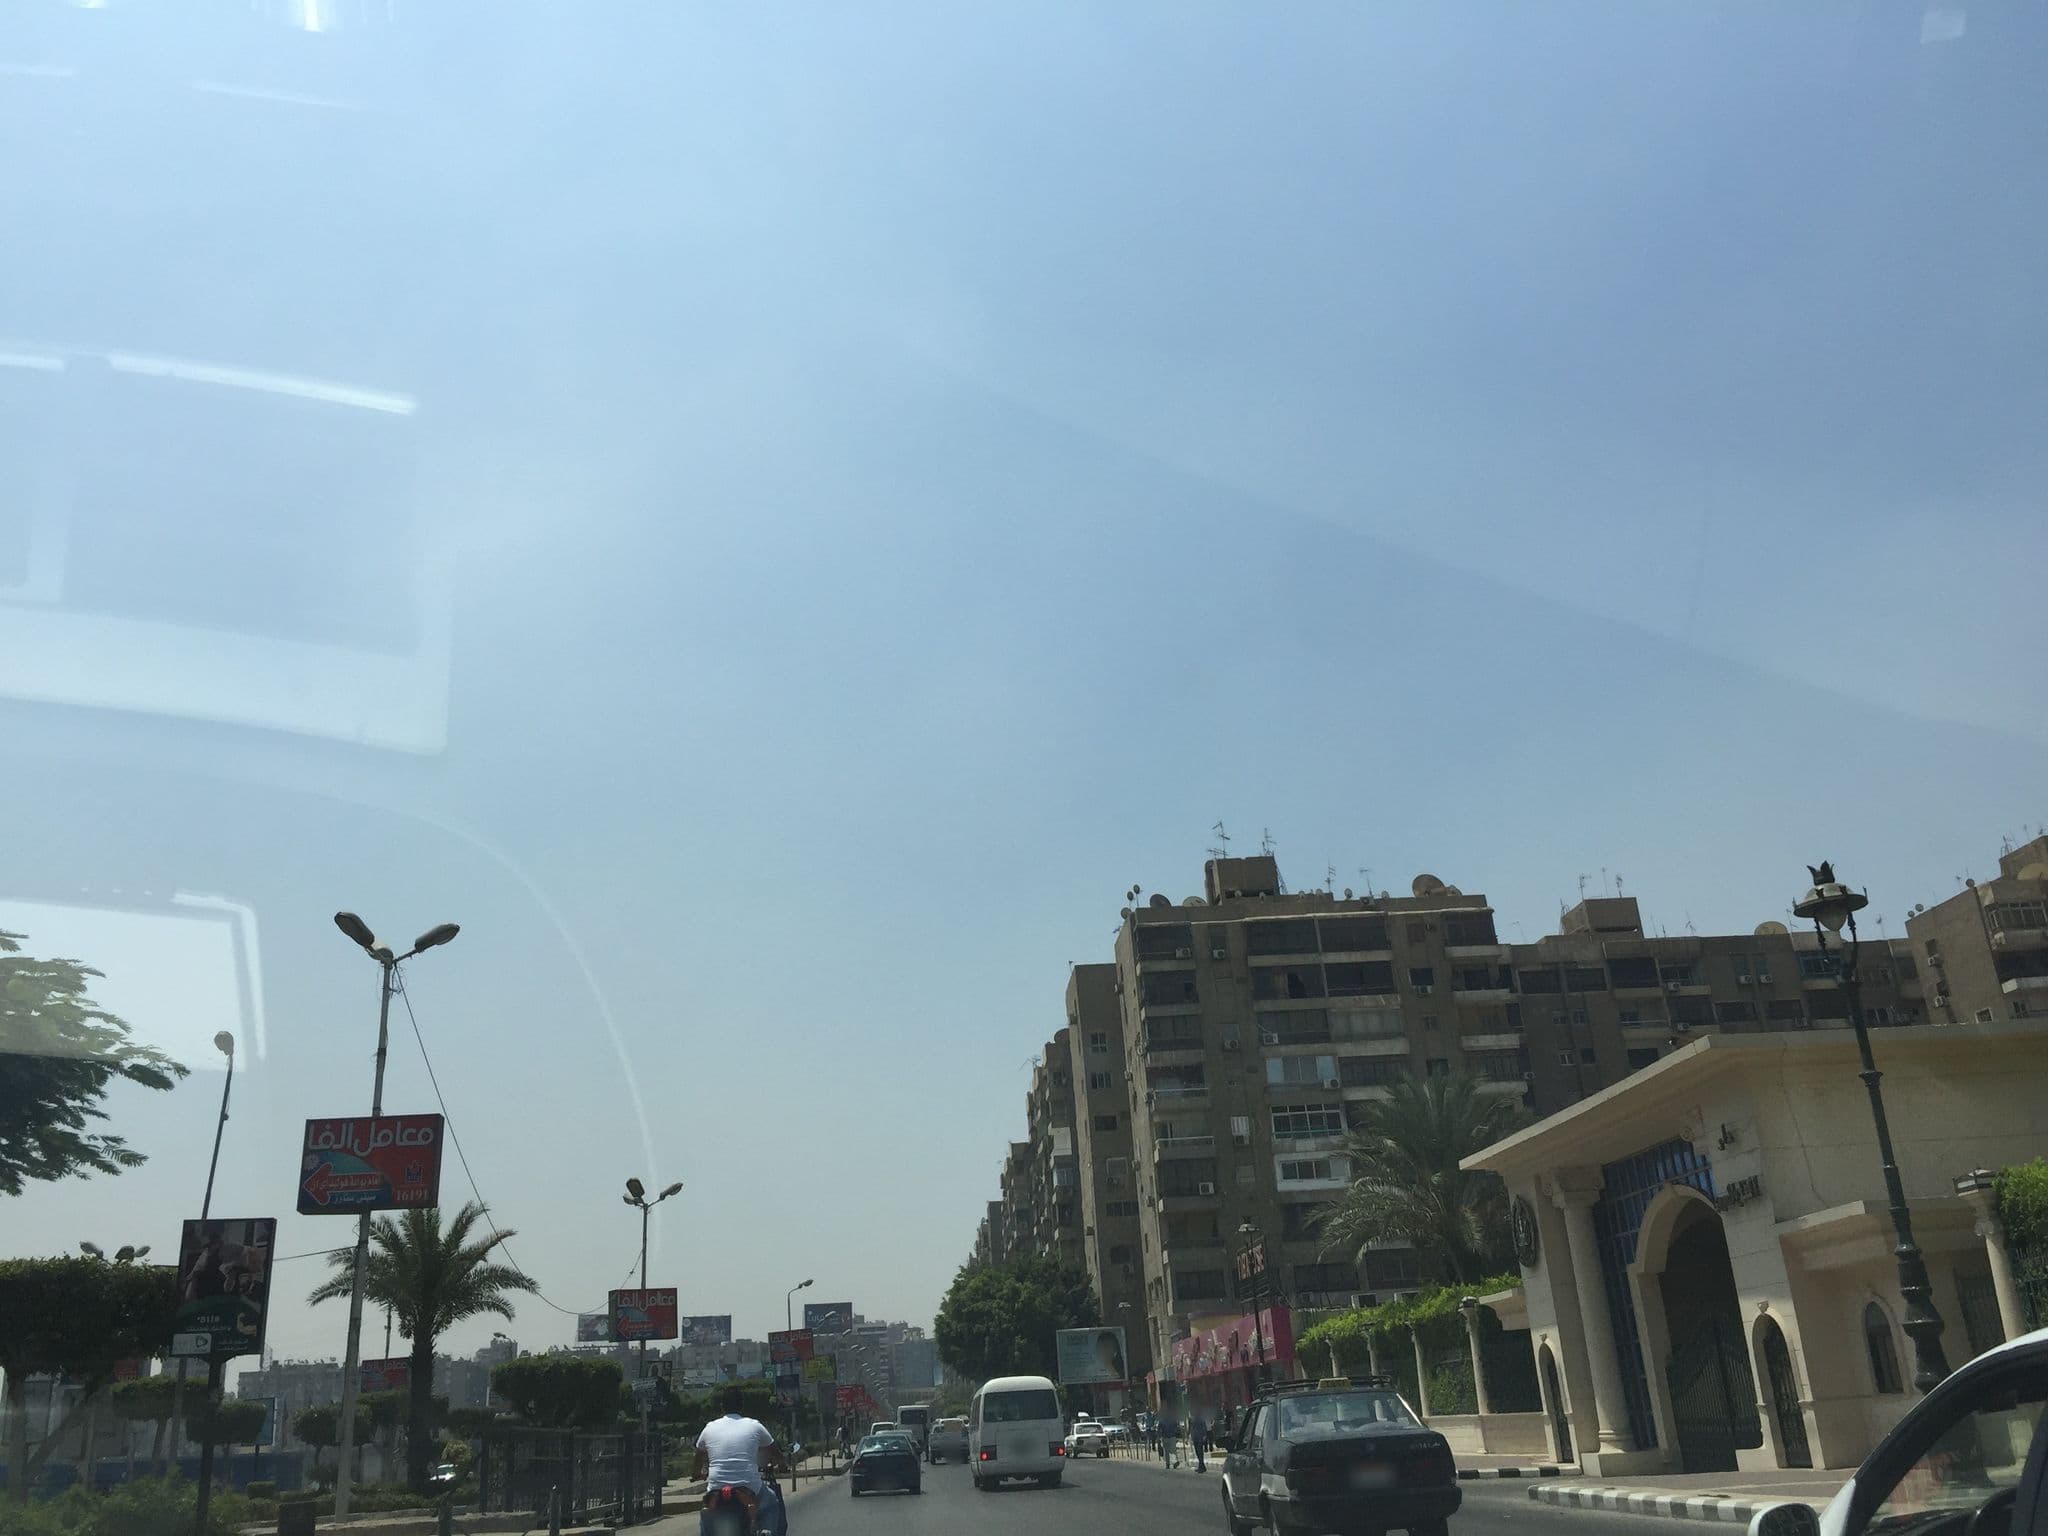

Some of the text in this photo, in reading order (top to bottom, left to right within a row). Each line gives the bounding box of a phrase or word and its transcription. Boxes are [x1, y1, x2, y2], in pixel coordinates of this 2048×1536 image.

[309, 1121, 434, 1156] معامل الفا
[395, 1187, 429, 1202] 16191
